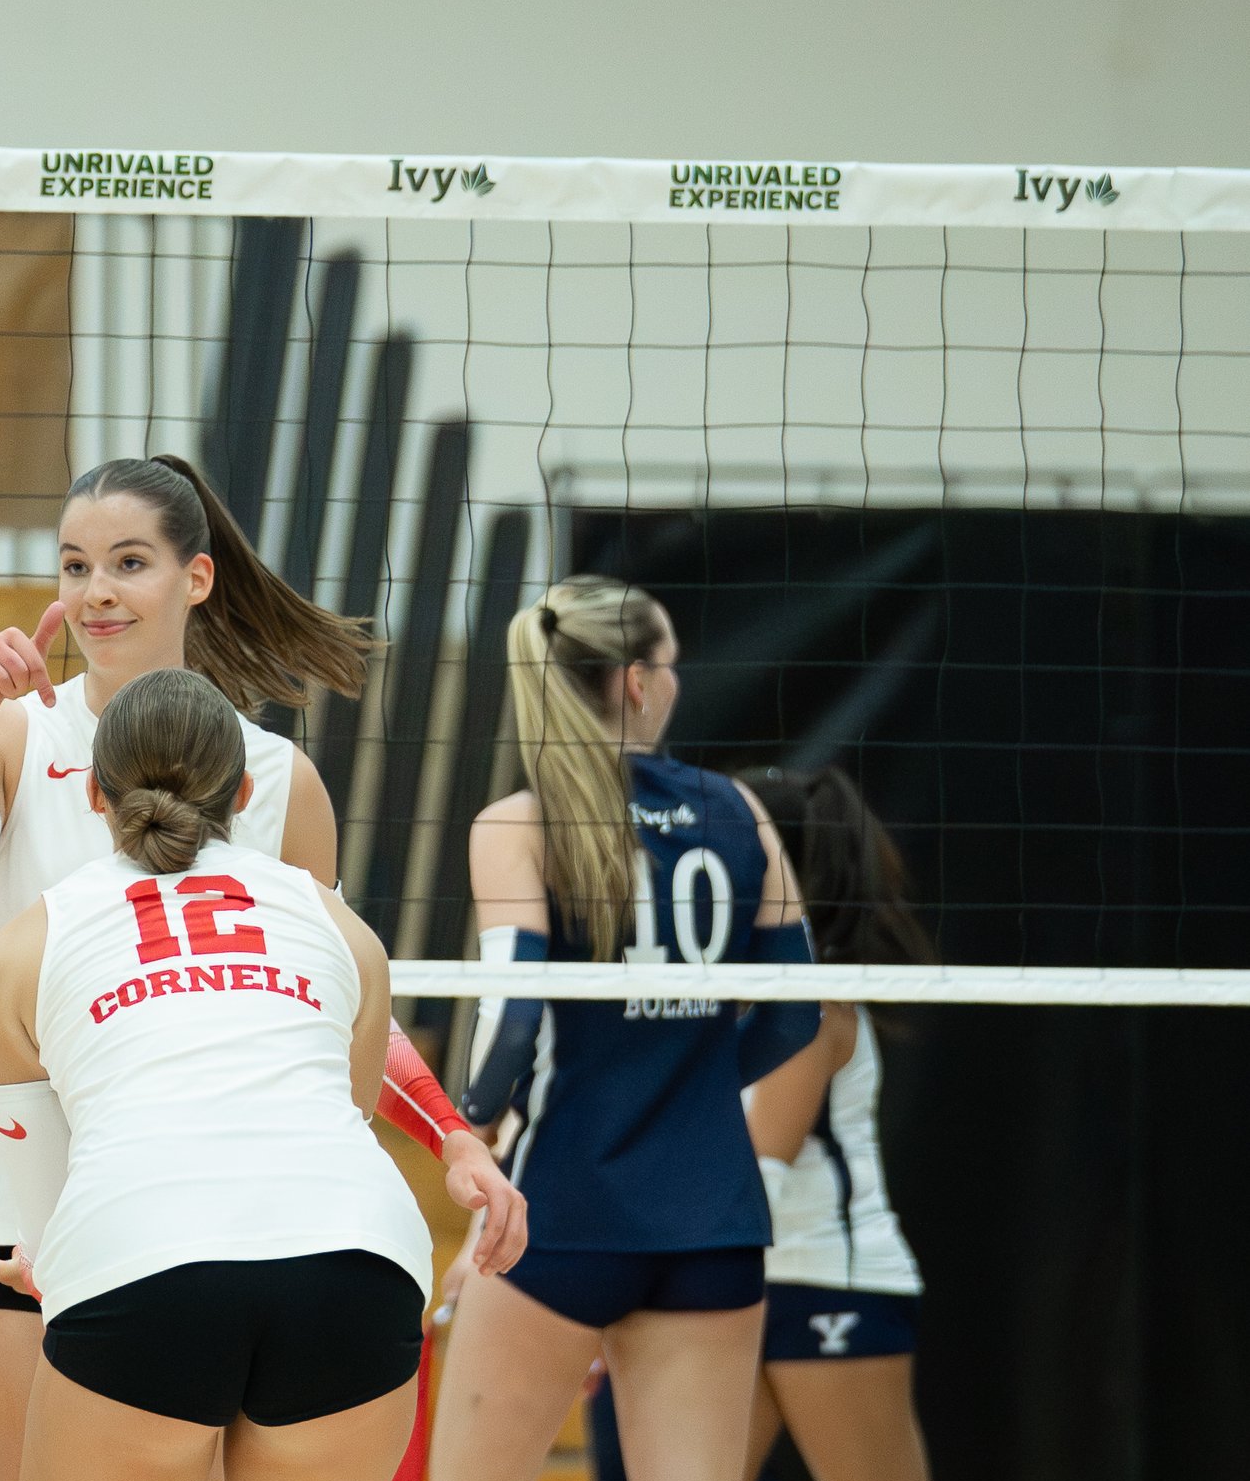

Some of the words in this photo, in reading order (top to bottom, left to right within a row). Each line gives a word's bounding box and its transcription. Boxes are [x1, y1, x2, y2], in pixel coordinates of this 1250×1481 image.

[42, 152, 214, 176] UNRIVALED
[387, 159, 457, 203] Ivy
[671, 164, 842, 187] UNRIVALED
[40, 177, 213, 200] EXPERIENCE
[669, 188, 840, 210] EXPERIENCE
[1013, 169, 1082, 213] Ivy
[125, 874, 267, 964] 12
[624, 847, 733, 964] 10
[89, 964, 322, 1024] CORNELL
[808, 1312, 860, 1354] Y
